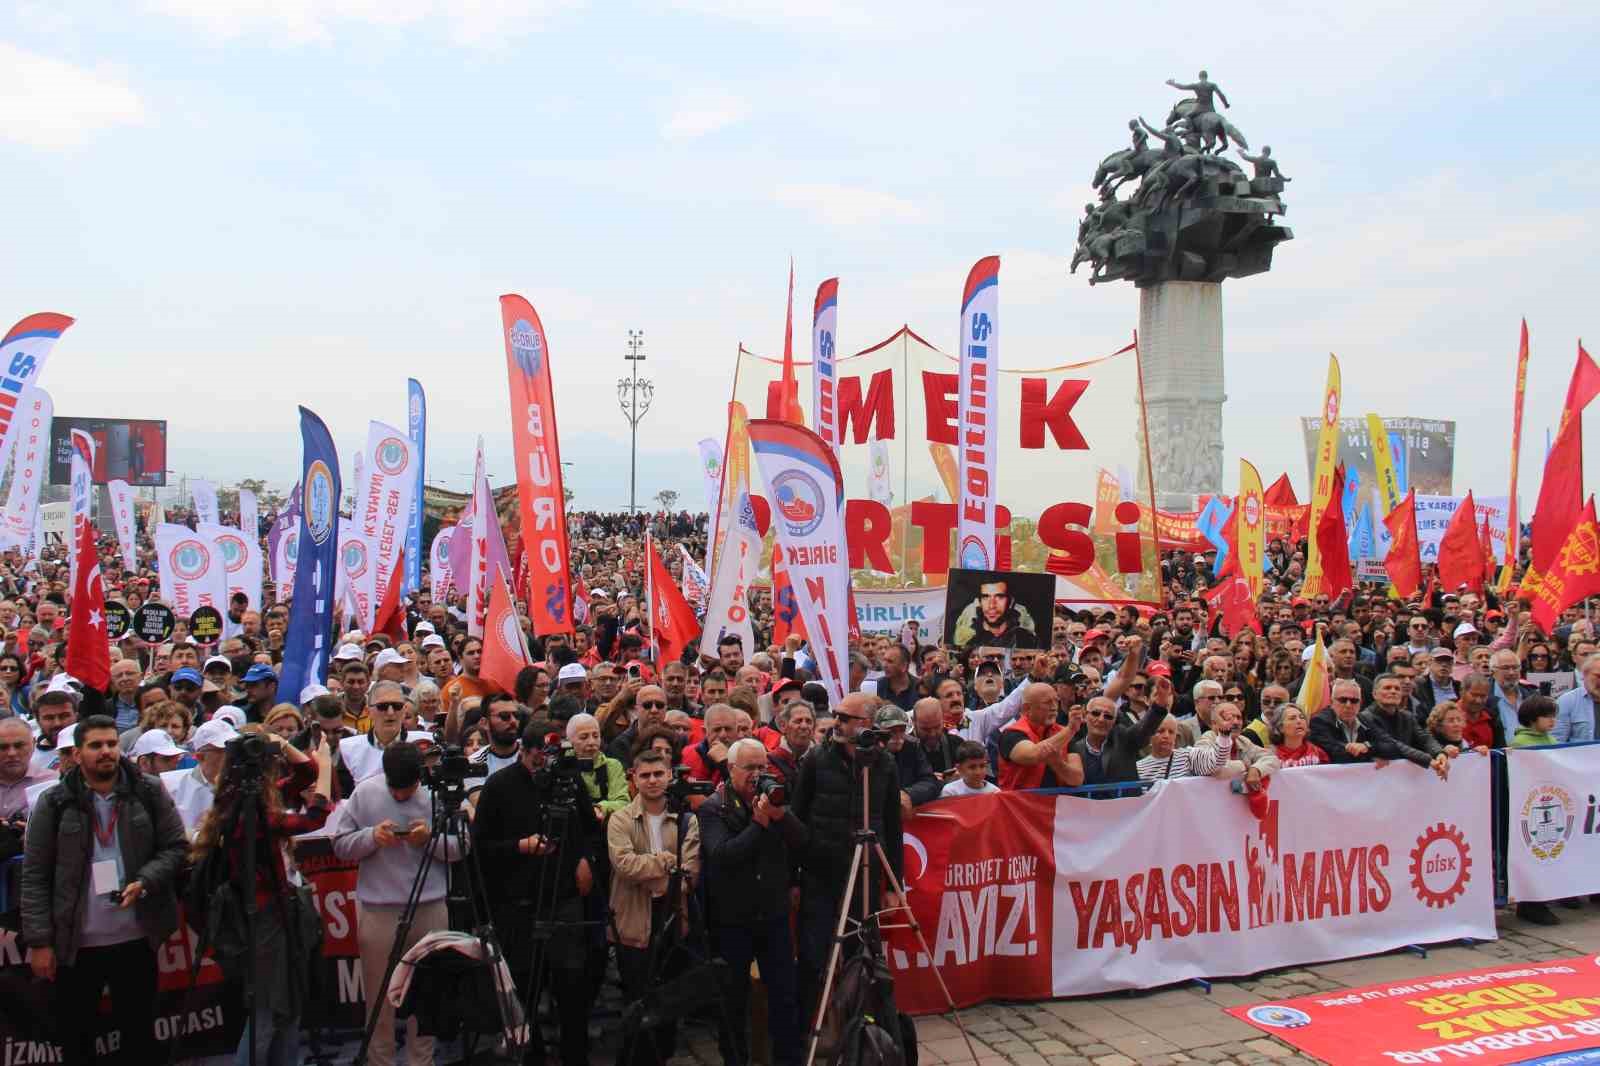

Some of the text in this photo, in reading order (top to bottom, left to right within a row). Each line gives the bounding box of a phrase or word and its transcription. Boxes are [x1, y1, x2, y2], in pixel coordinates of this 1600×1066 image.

[767, 368, 1091, 450] MEK
[856, 603, 927, 622] BİRLİK
[944, 857, 1004, 887] ÜRRİYET
[1425, 852, 1457, 875] DİSK
[1068, 861, 1241, 954] YAŞASIN
[1283, 844, 1392, 924] MAYIS
[1382, 1024, 1577, 1064] ZORBALAR
